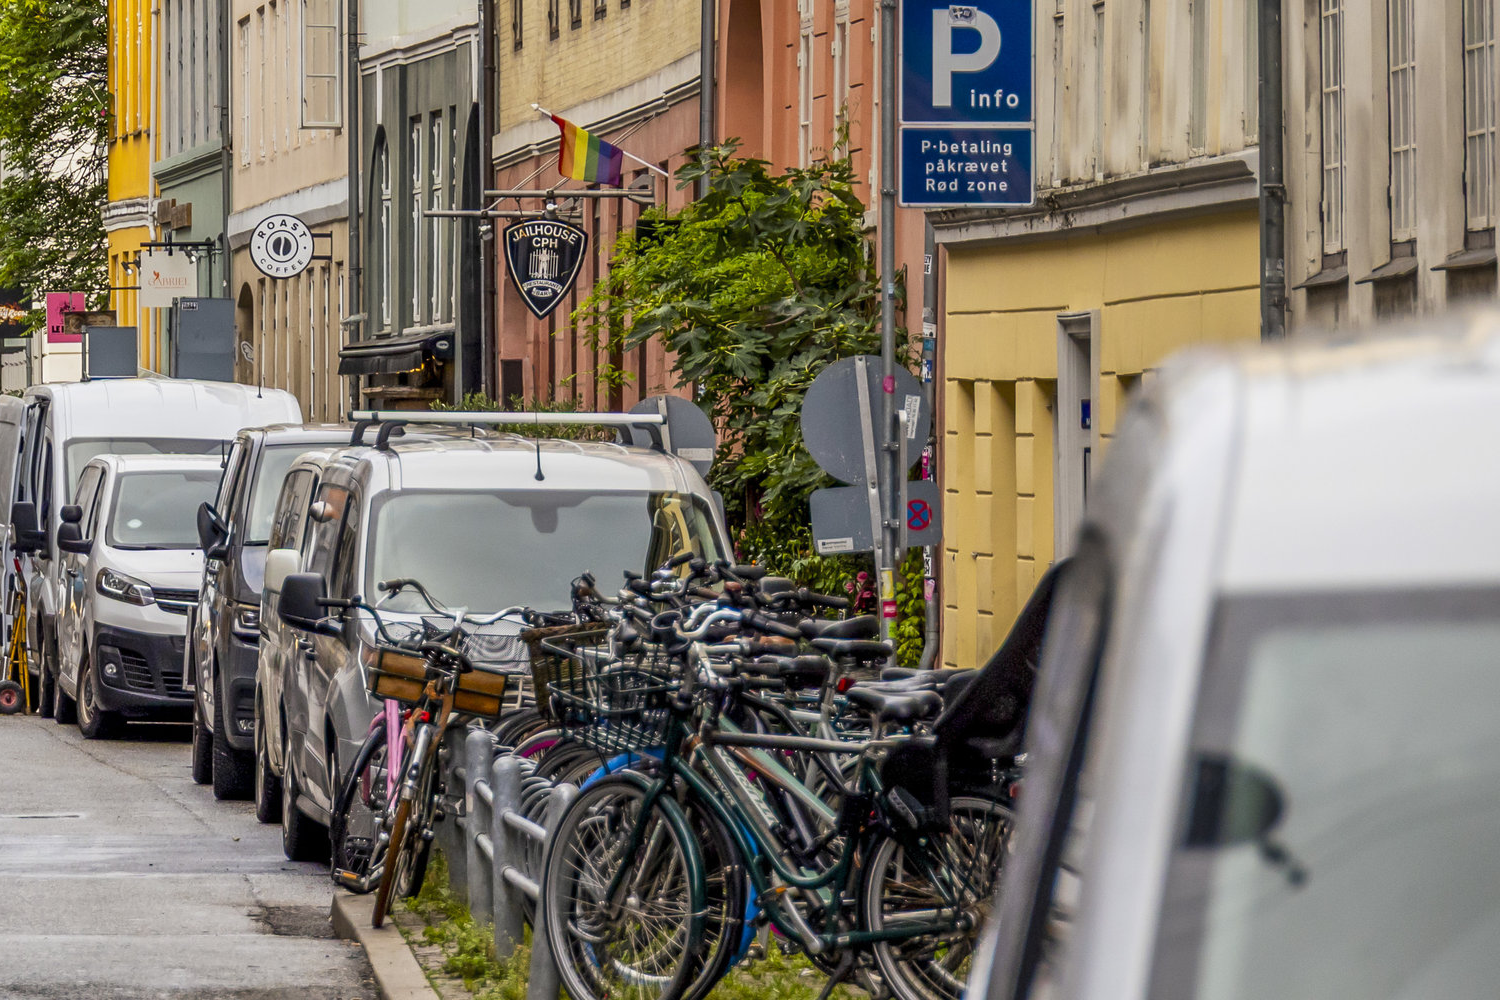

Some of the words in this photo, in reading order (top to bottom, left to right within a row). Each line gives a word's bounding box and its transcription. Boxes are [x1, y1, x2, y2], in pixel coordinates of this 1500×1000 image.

[932, 8, 1001, 107] P
[970, 89, 1019, 108] info
[925, 159, 1008, 175] påkrævet
[926, 178, 958, 191] Rød
[967, 181, 1008, 191] zone
[257, 219, 307, 239] ROAST
[512, 225, 578, 245] JAILHOUSE
[532, 237, 558, 248] CPH
[260, 258, 303, 273] COFFEE
